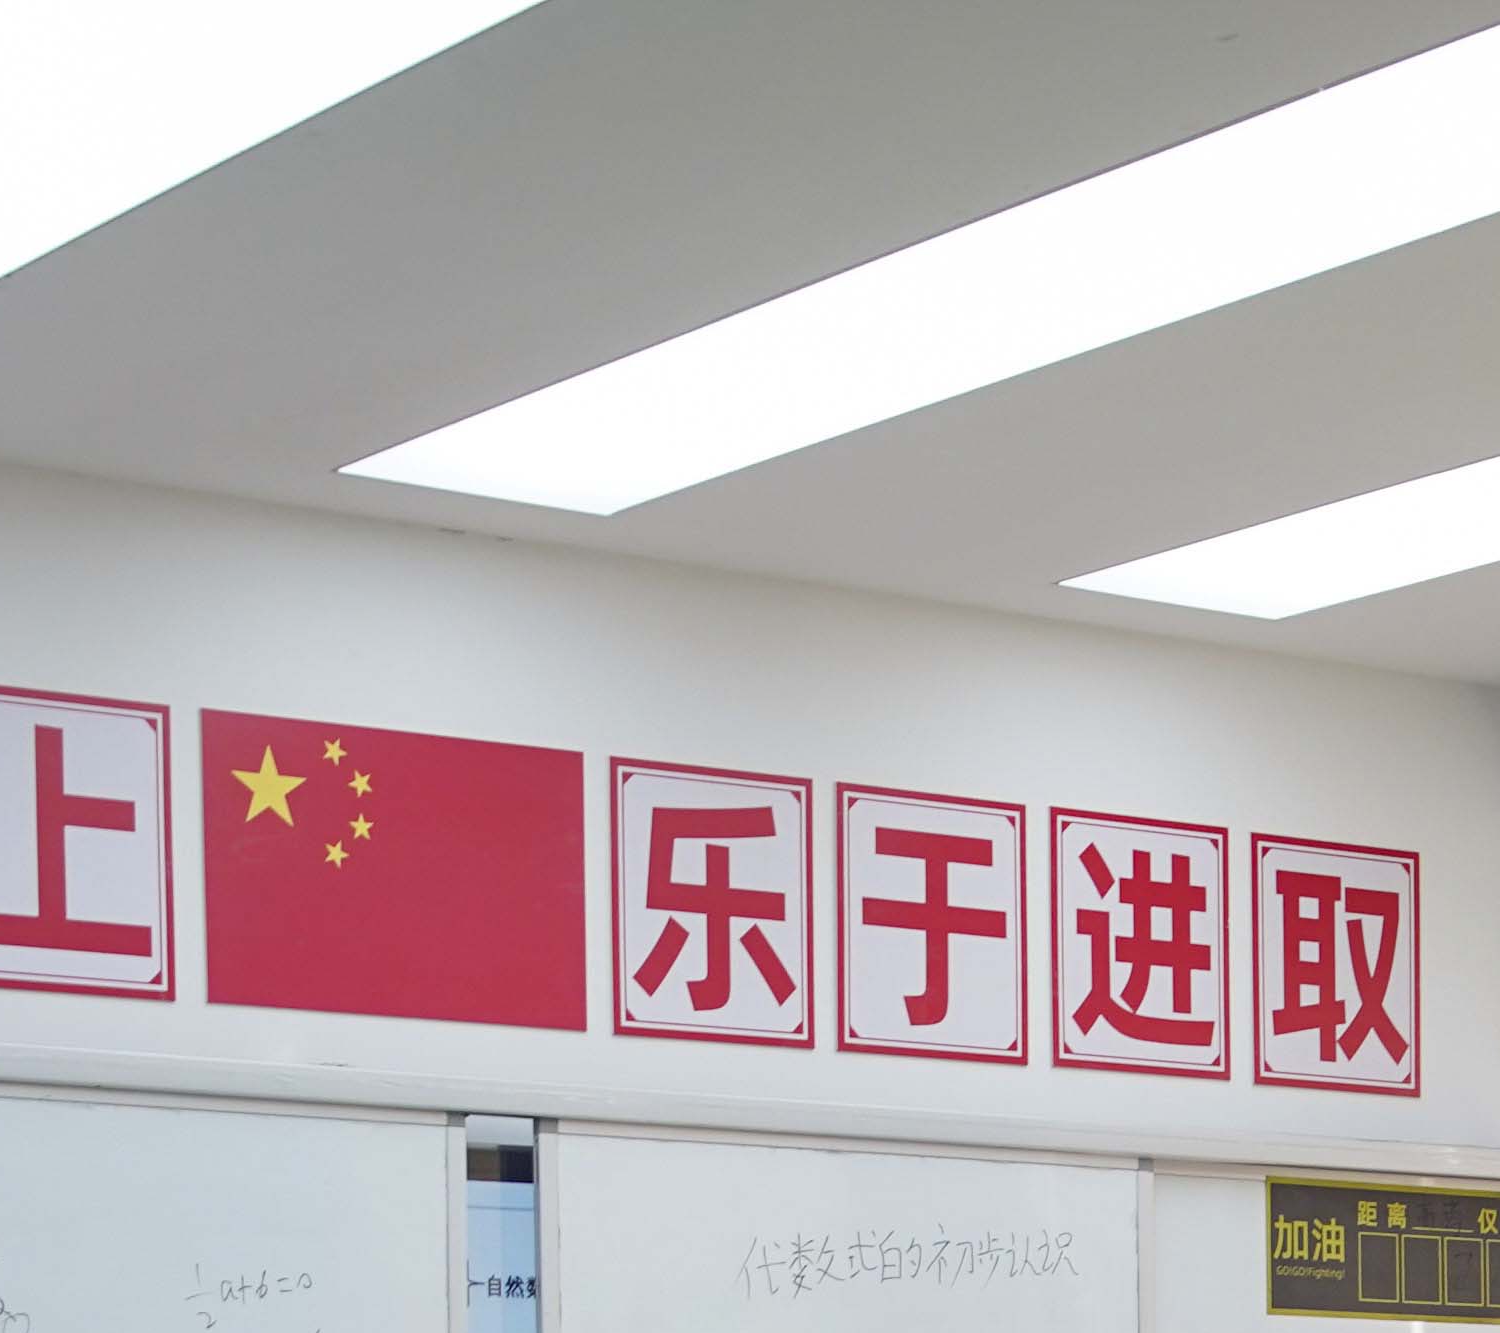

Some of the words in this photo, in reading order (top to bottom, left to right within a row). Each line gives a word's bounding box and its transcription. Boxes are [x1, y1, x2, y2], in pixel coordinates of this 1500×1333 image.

[632, 804, 1409, 1064] 乐于进取
[1273, 1213, 1345, 1264] 加油
[1357, 1200, 1406, 1230] 距离
[737, 1222, 1081, 1298] 代数式的初步认识
